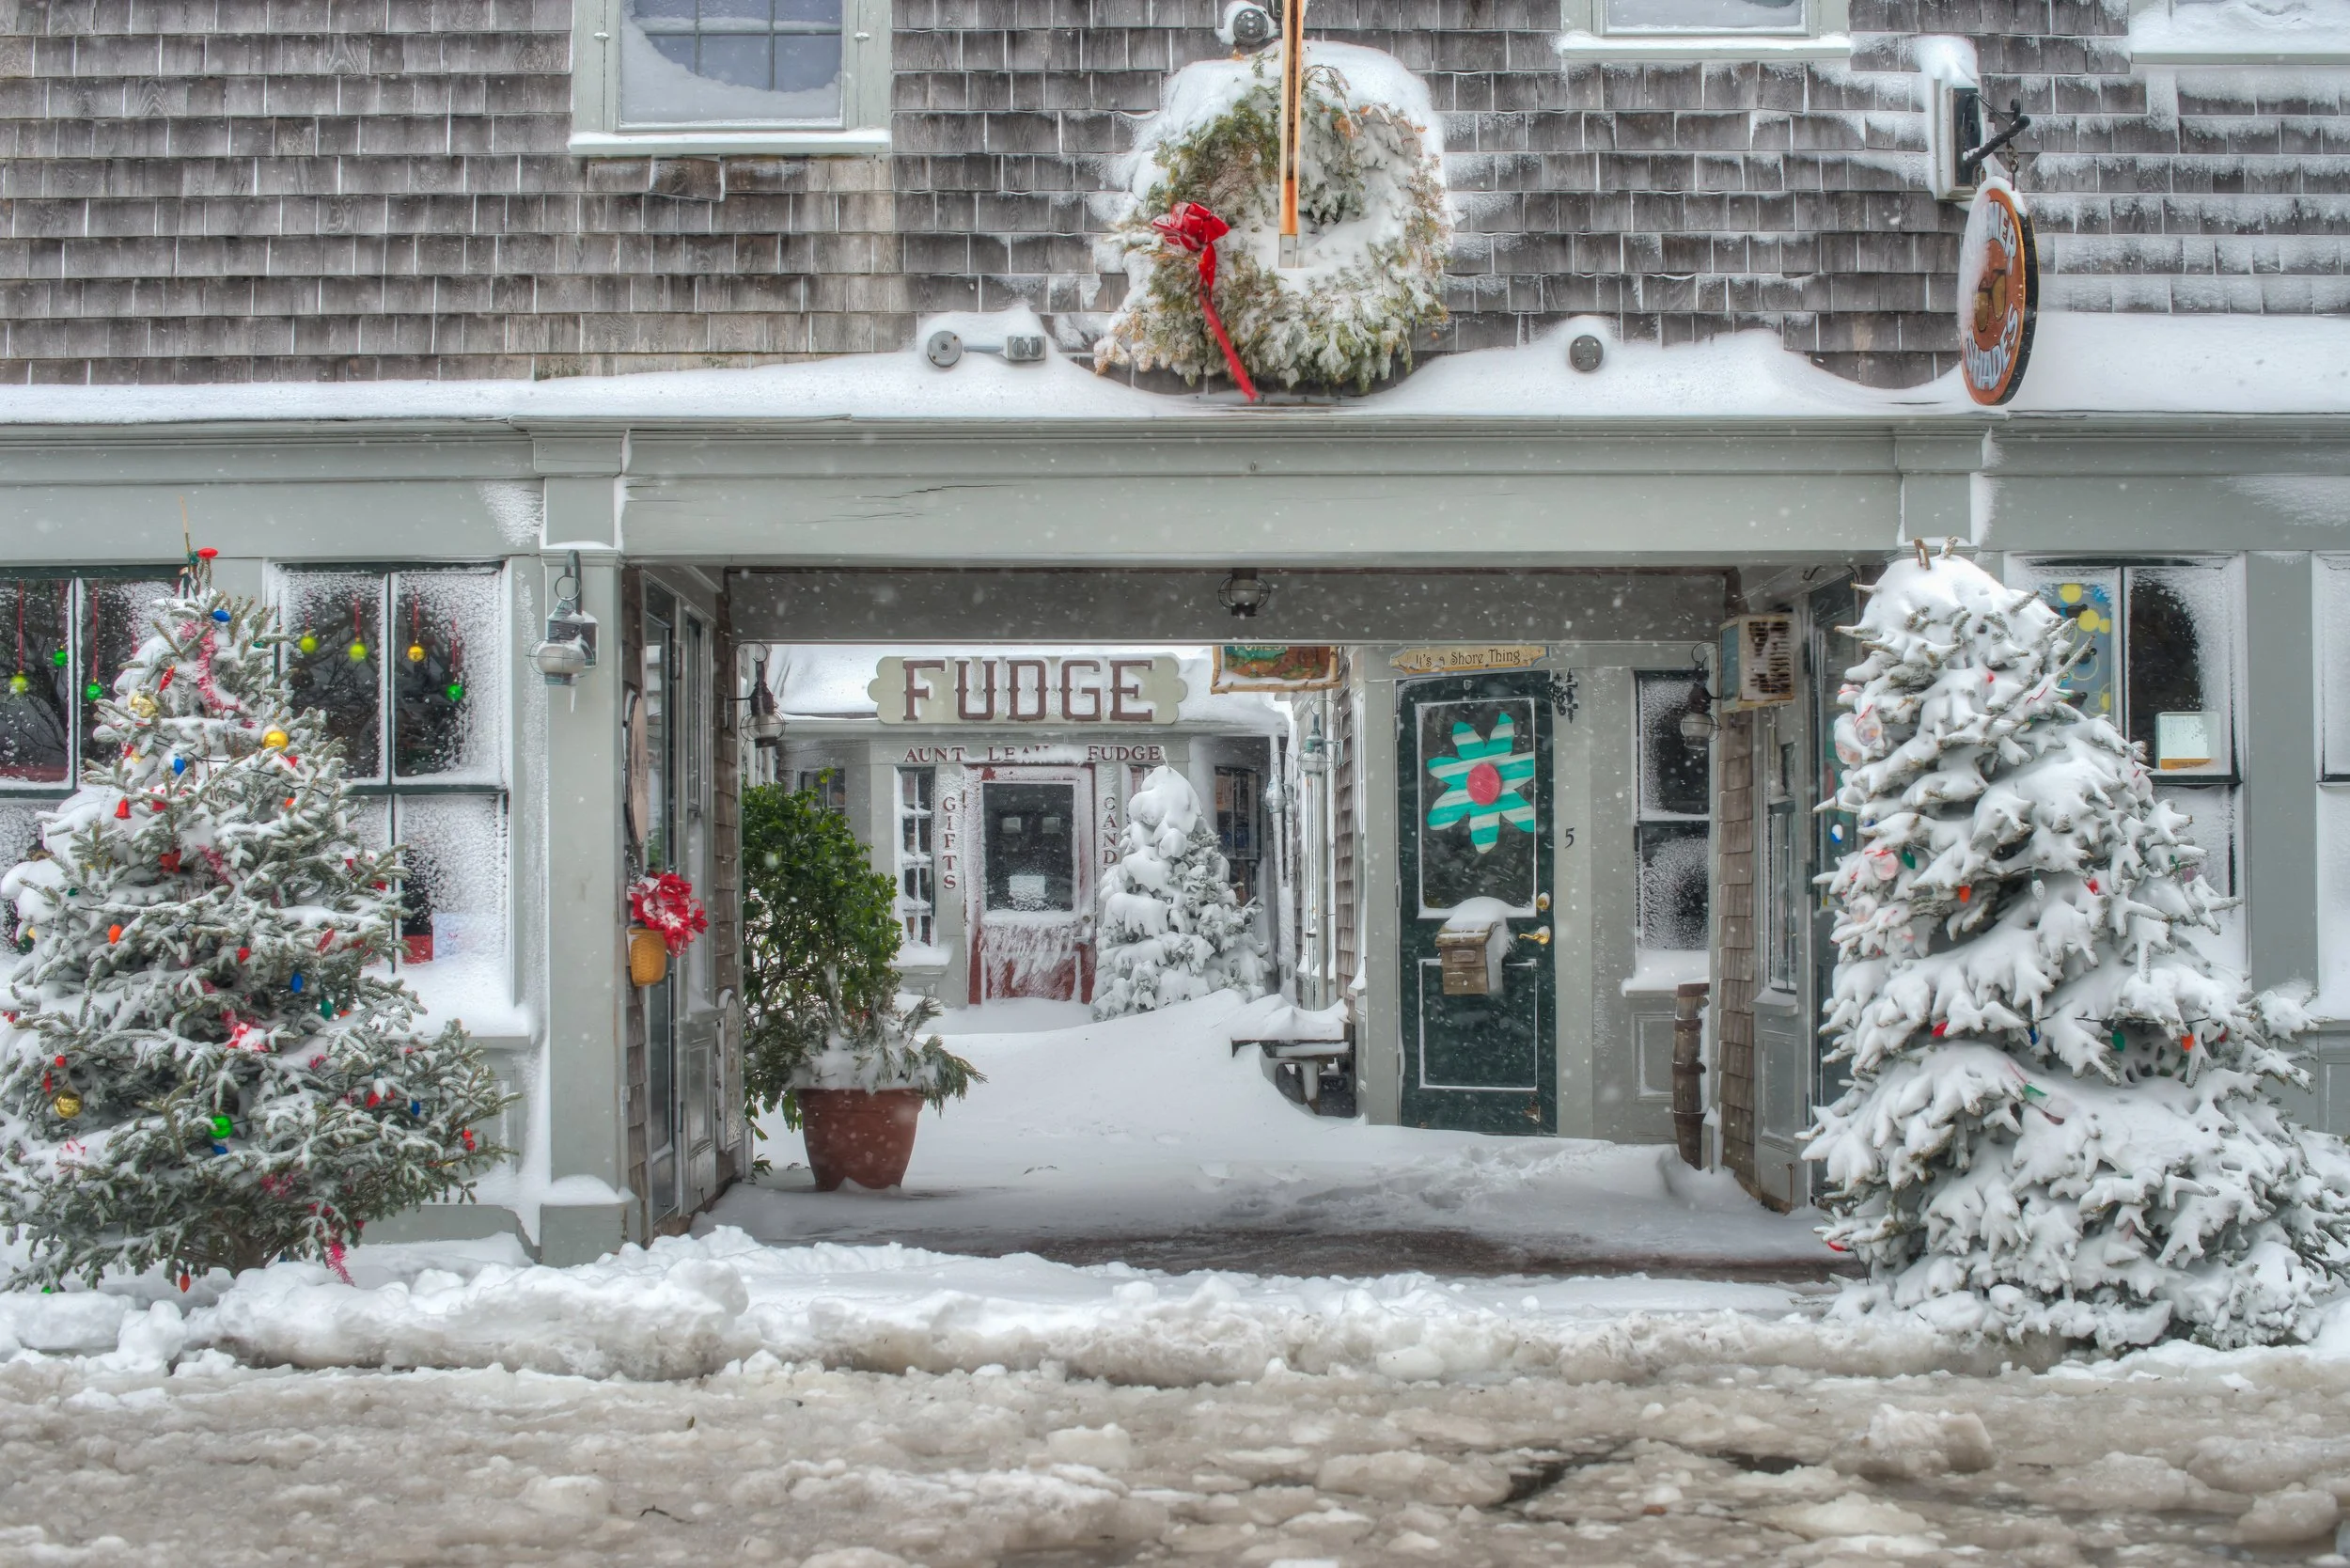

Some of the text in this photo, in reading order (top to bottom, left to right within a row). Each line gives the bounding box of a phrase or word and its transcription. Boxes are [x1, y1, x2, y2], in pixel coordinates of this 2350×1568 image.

[1965, 302, 2018, 391] SHADES
[1450, 651, 1484, 666] Shore
[1488, 649, 1521, 666] Thing
[902, 659, 1153, 722] FUDGE
[903, 745, 1162, 762] AUNT FUDGE
[942, 796, 958, 890] GIFTS
[1104, 796, 1118, 872] CAND
[1564, 827, 1575, 848] 5
